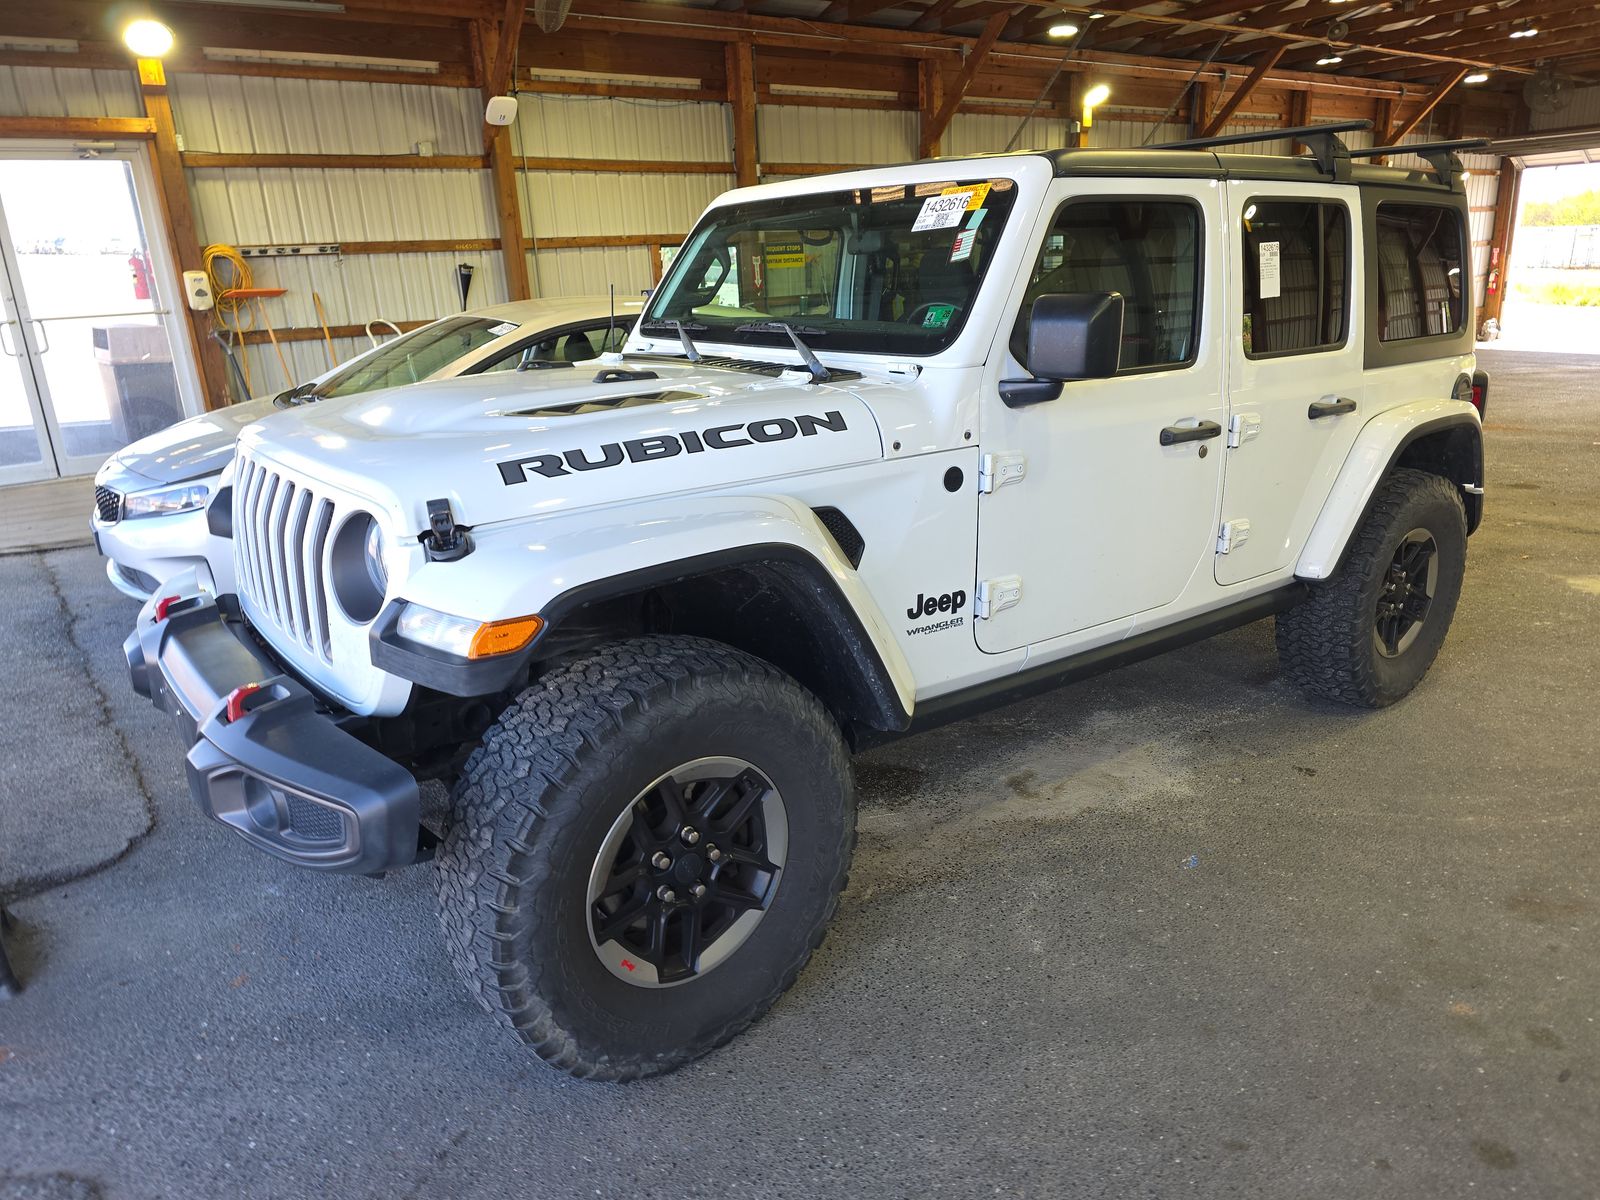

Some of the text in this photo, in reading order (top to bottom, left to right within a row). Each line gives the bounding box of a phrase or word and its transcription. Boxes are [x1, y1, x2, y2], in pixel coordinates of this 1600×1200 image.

[924, 195, 971, 214] 1432616
[496, 410, 848, 486] RUBICON
[907, 590, 966, 619] Jeep
[906, 617, 964, 636] WRANGLER
